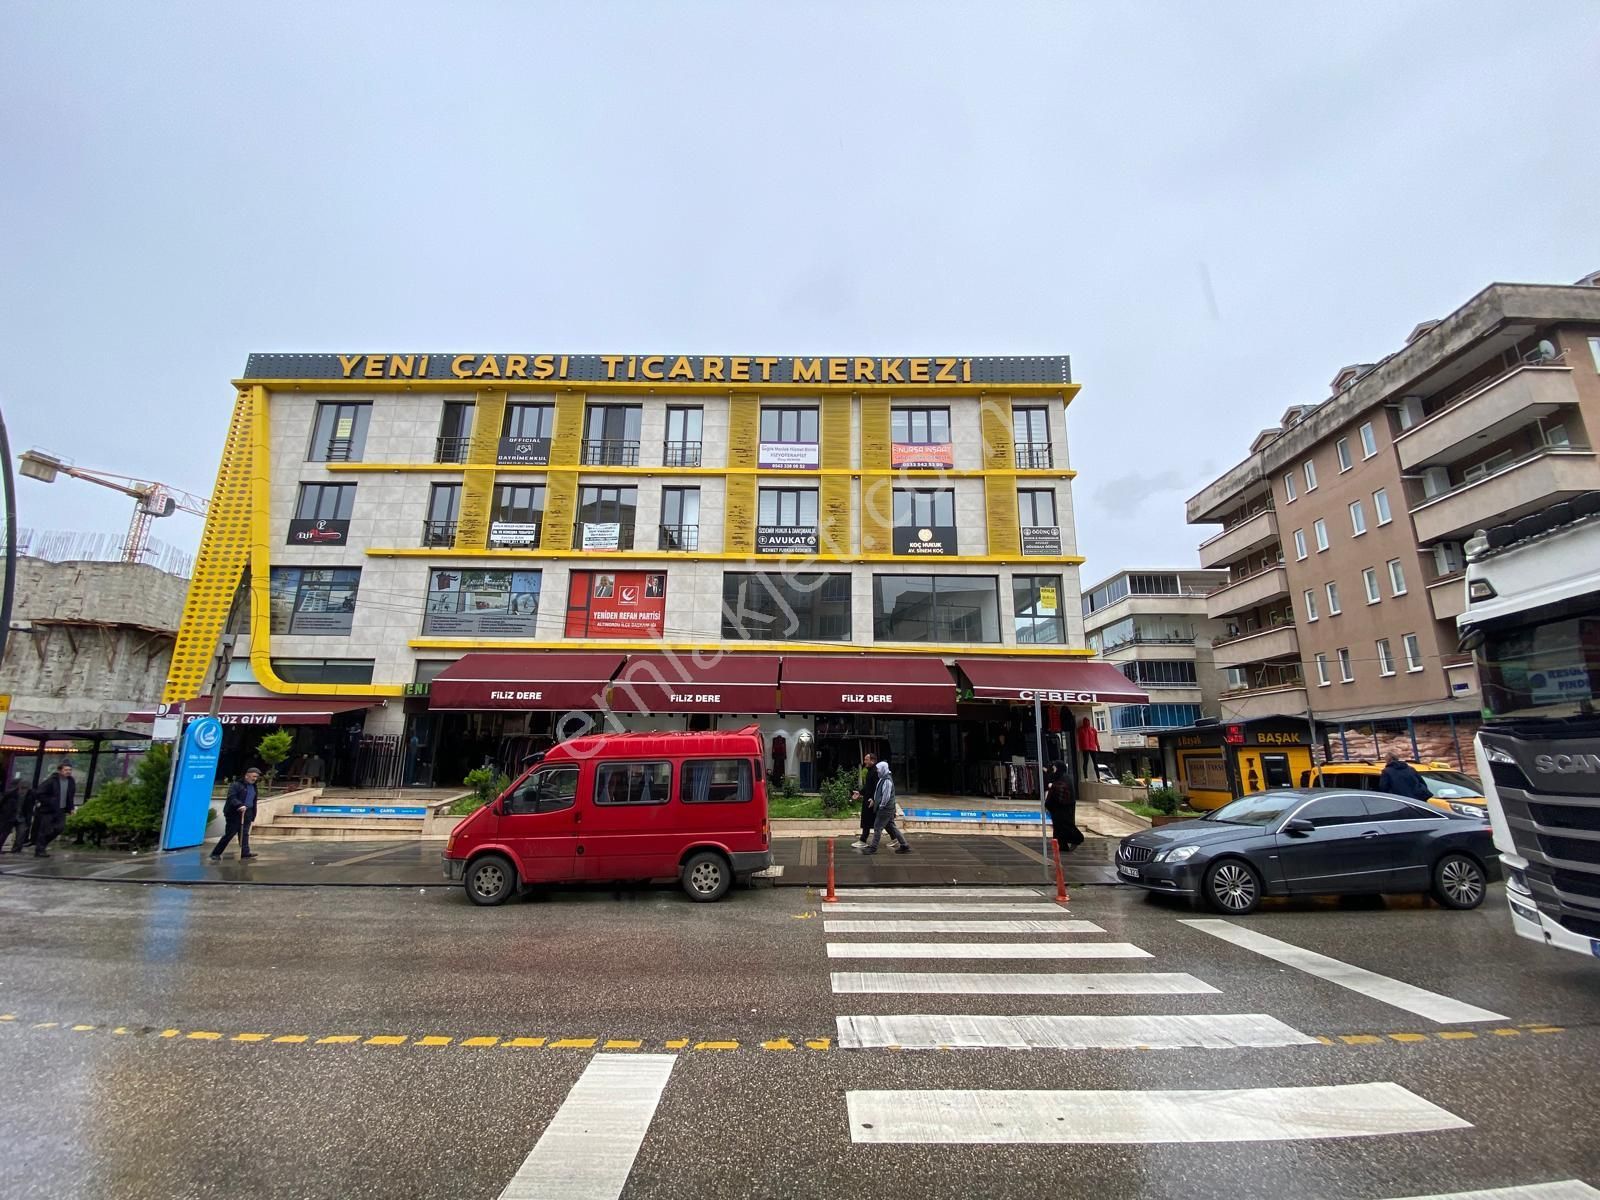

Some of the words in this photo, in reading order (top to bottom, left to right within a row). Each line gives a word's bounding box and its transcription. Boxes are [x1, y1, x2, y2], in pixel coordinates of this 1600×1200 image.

[451, 354, 569, 380] ÇARŞI
[768, 536, 806, 544] AVUKAT
[593, 610, 619, 620] YENİDEN
[619, 612, 638, 620] REFAH
[638, 611, 661, 620] PARTİSİ
[516, 692, 543, 700] DERE
[695, 694, 721, 703] DERE
[867, 694, 893, 703] DERE
[241, 714, 277, 724] GİYİM
[1257, 732, 1300, 746] BAŞAK
